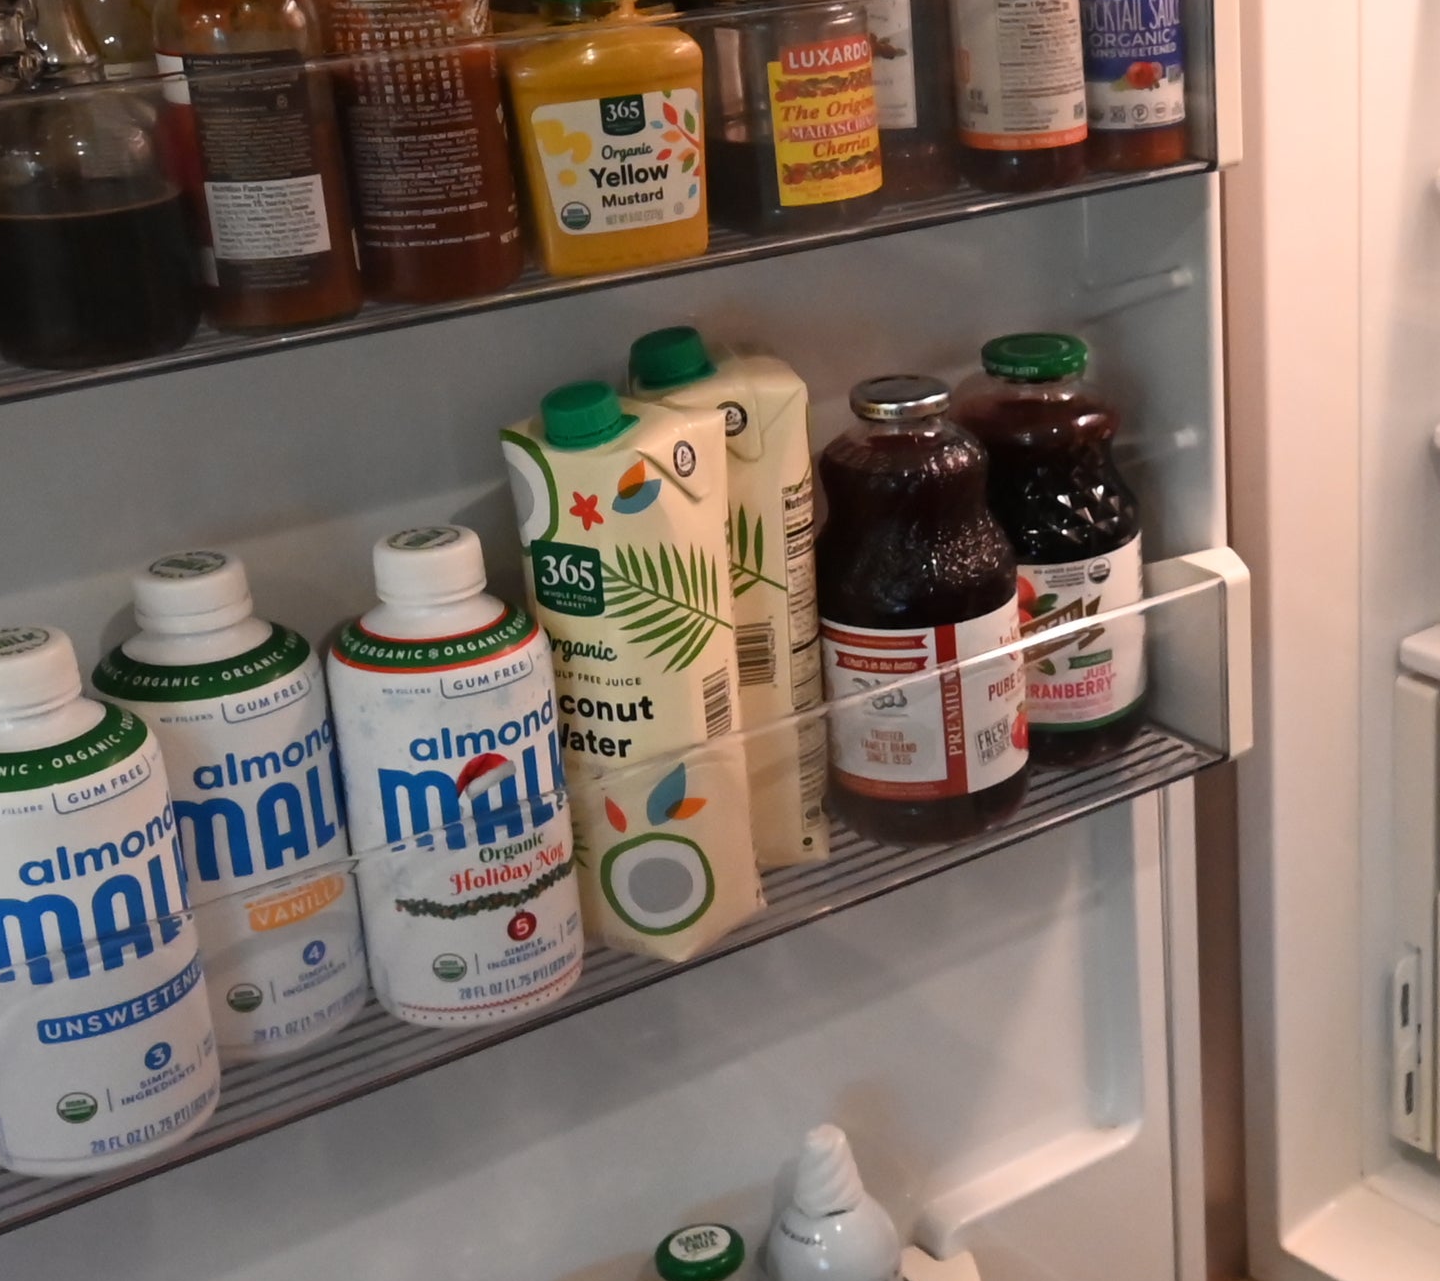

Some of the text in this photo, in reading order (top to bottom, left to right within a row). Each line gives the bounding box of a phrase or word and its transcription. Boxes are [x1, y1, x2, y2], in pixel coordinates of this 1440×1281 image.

[1090, 28, 1172, 47] ORGANIC
[1091, 42, 1177, 58] UNSWEETENED
[789, 40, 871, 69] LUXARDO
[606, 101, 640, 122] 365
[782, 105, 819, 122] The
[601, 143, 653, 163] Organic
[813, 136, 870, 157] Cherries
[589, 164, 669, 188] Yellow
[602, 188, 664, 208] Mustard
[541, 553, 596, 591] 365
[543, 590, 597, 605] WHOLE FOODS
[556, 600, 586, 609] MARKET
[359, 631, 509, 660] ORGANIC ORGANIC
[545, 628, 617, 663] rganic
[132, 651, 283, 688] ORGANIC ORGANIC
[453, 661, 527, 691] GUM FREE
[578, 673, 642, 687] FREE JUICE
[1084, 663, 1112, 681] JUST
[235, 680, 304, 716] GUM FREE
[988, 676, 1015, 701] PURE
[1030, 677, 1112, 700] RANBERRY
[560, 695, 654, 722] conut
[948, 670, 963, 757] PREMIUM
[409, 689, 553, 762] almond
[977, 719, 1009, 749] FRESH
[51, 733, 121, 769] ORGANIC
[67, 764, 145, 805] GUM FREE
[1, 804, 44, 815] FILLERS
[19, 791, 173, 886] almond
[479, 832, 544, 864] Organic
[450, 841, 565, 896] Holiday Nog
[254, 876, 339, 926] VANILL
[515, 918, 530, 936] 5
[308, 944, 320, 960] 4
[487, 941, 558, 971] INGREDIENTS
[504, 937, 543, 958] SIMPLE
[459, 974, 532, 1000] 28 FL OZ (1.75
[44, 963, 201, 1040] UNSWEETENE
[152, 1047, 165, 1066] 3
[121, 1064, 196, 1106] INGREDIENTS
[139, 1063, 180, 1089] SIMPLE
[91, 1115, 173, 1154] 28 FL OZ (1.75
[677, 1229, 719, 1247] SANTA
